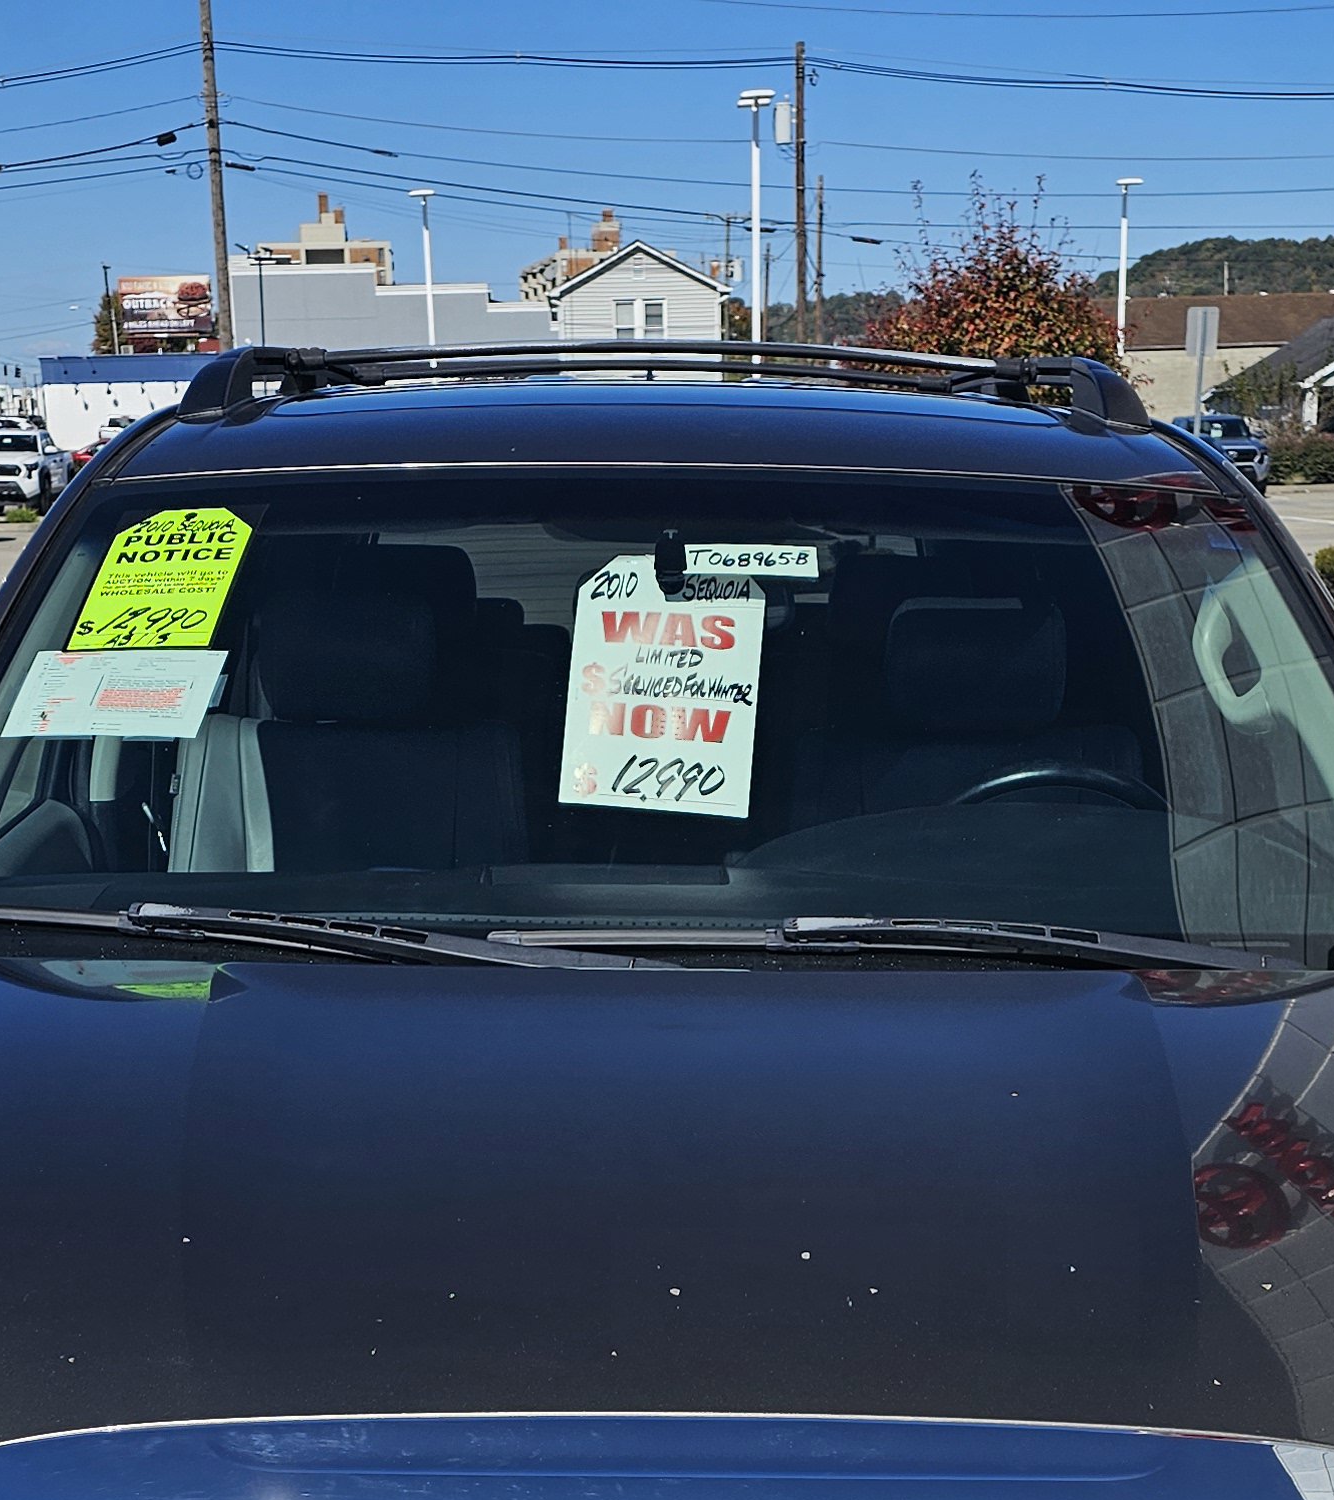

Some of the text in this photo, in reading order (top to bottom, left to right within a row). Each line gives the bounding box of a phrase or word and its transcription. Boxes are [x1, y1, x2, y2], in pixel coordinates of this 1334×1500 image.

[133, 520, 175, 534] 2010
[123, 531, 238, 547] PUBLIC
[116, 547, 234, 564] NOTICE
[101, 588, 175, 597] WHOLESALE
[590, 570, 750, 602] 2010 SEQUOIA
[601, 611, 736, 650] WAS
[635, 645, 704, 668] LIMITED
[588, 701, 732, 743] NOW
